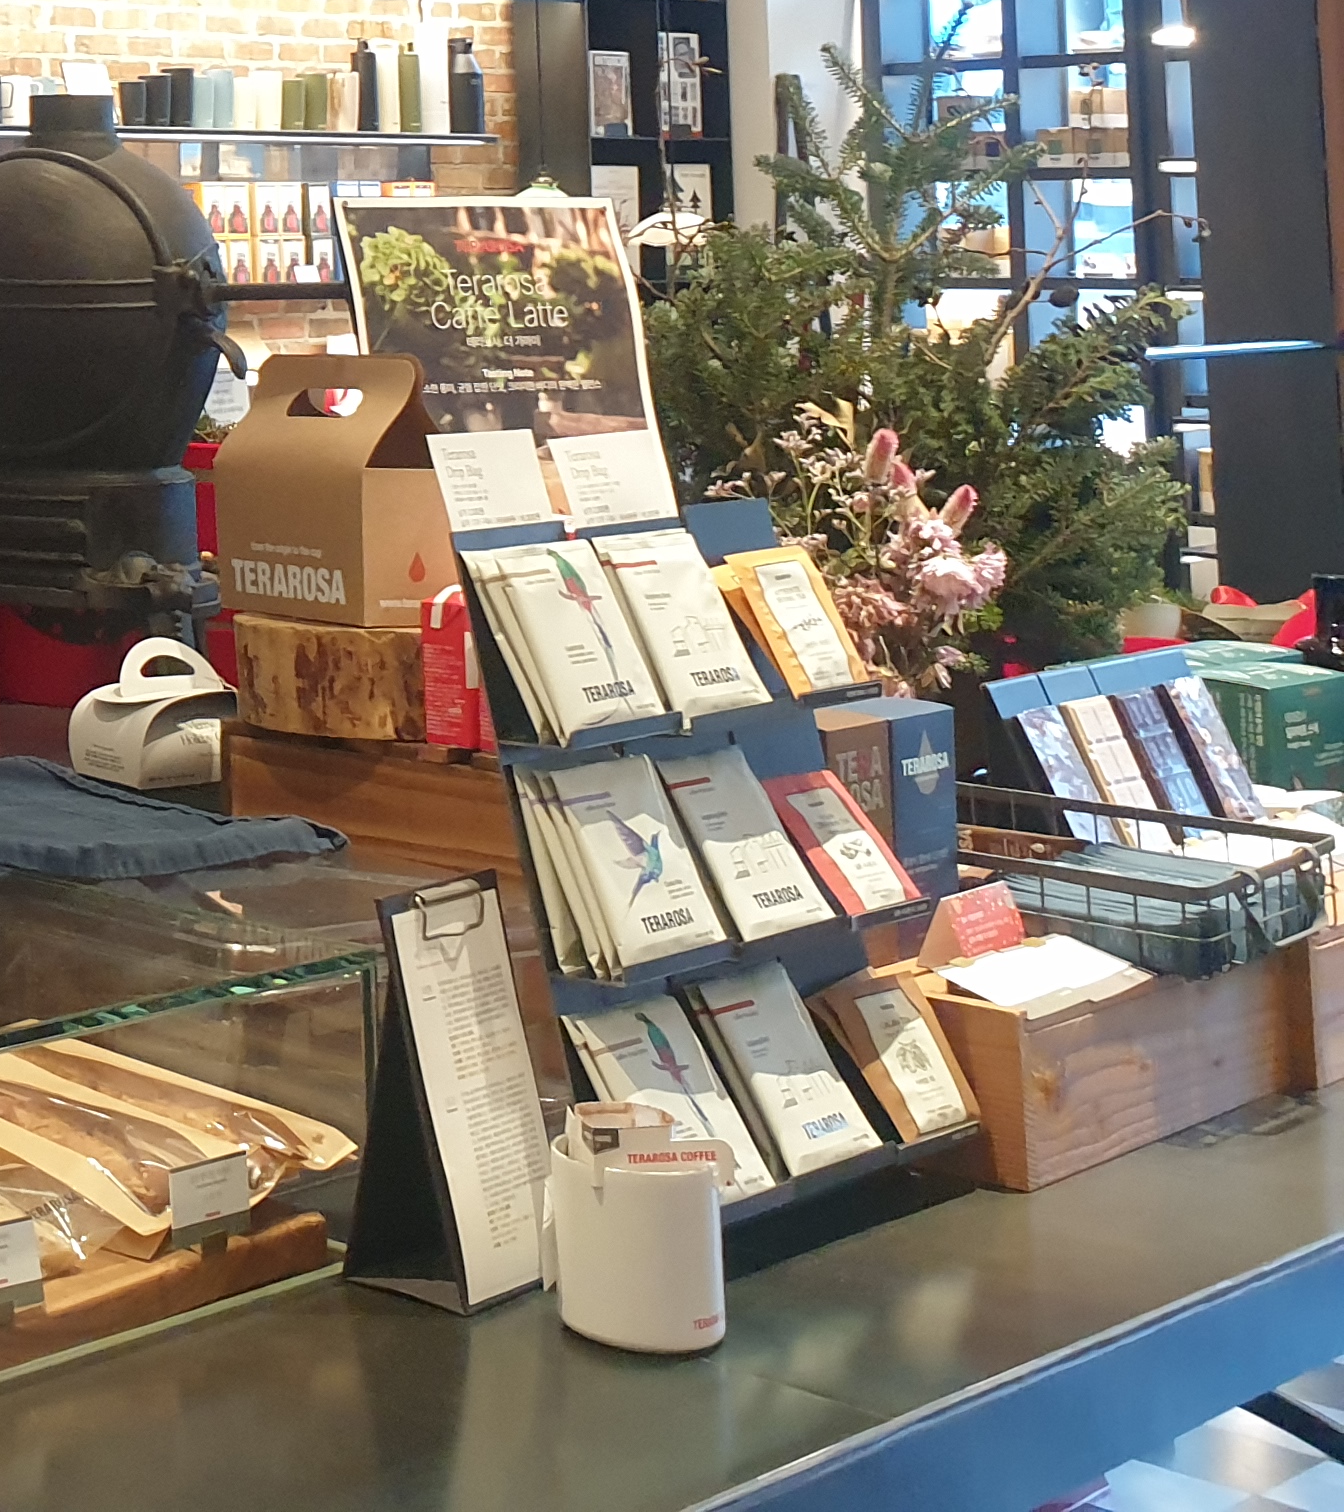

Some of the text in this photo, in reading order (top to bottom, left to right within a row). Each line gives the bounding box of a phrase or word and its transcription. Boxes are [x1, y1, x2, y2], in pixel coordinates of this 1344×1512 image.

[440, 268, 548, 297] Terarosa
[508, 300, 569, 328] Latte
[230, 558, 347, 606] TERAROSA
[689, 666, 741, 687] TERAROSA
[581, 679, 636, 704] TERAROSA
[900, 750, 950, 777] TERAROSA
[752, 884, 804, 909] TERAROSA
[640, 907, 695, 934] TERAROSA
[627, 1149, 717, 1165] TERAROSA COFFEE
